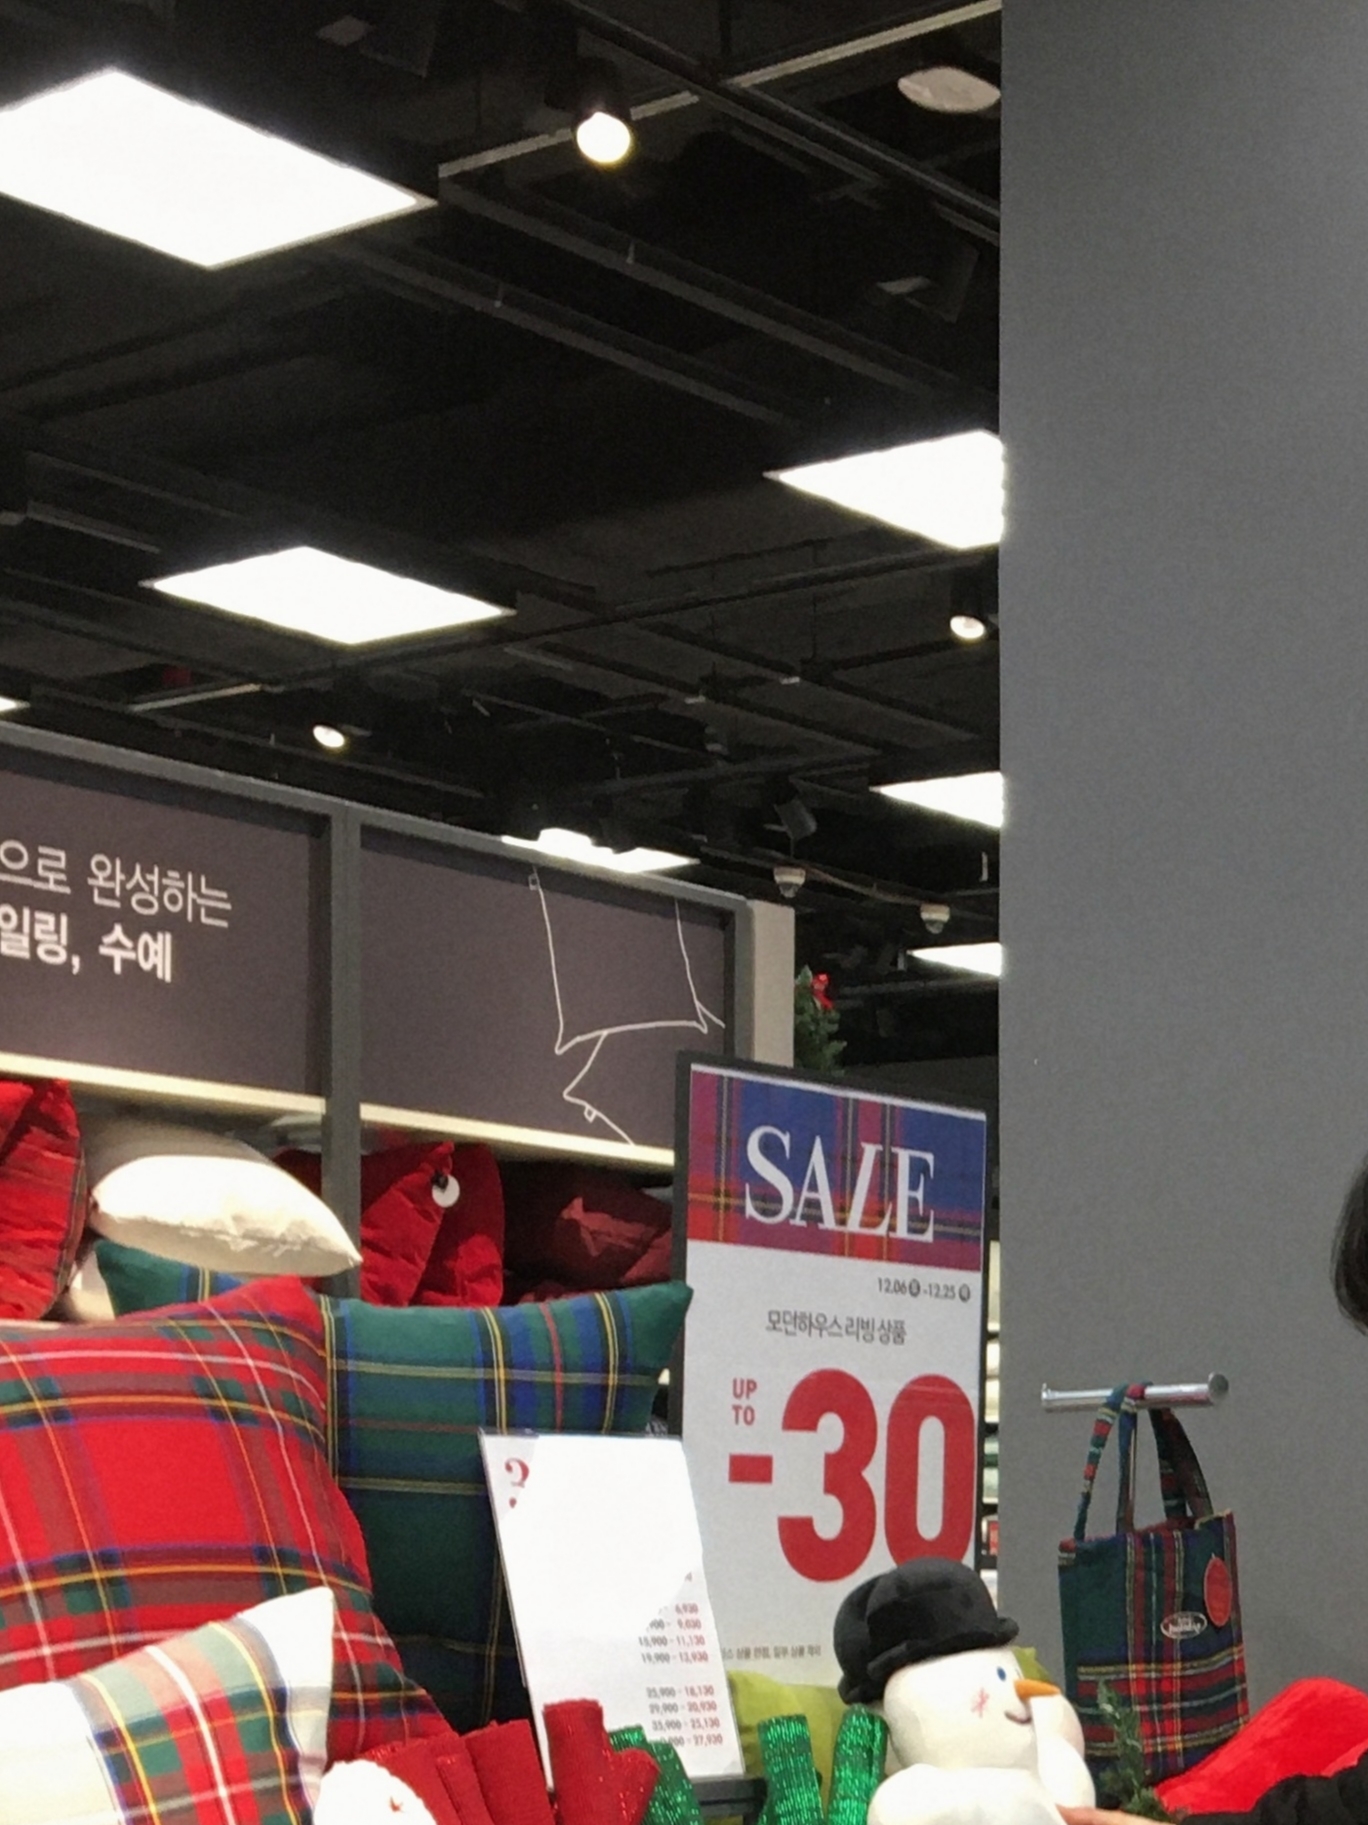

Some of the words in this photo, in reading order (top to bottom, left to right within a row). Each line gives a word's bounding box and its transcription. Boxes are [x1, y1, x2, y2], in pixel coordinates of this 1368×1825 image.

[87, 853, 232, 928] 완성하는
[99, 922, 172, 983] 수예
[745, 1124, 935, 1243] SALE
[766, 1309, 844, 1338] 모던하우스
[845, 1316, 875, 1344] 리빙
[877, 1318, 907, 1346] 상품
[732, 1378, 758, 1400] UP
[732, 1405, 756, 1426] TO
[728, 1368, 976, 1582] -30
